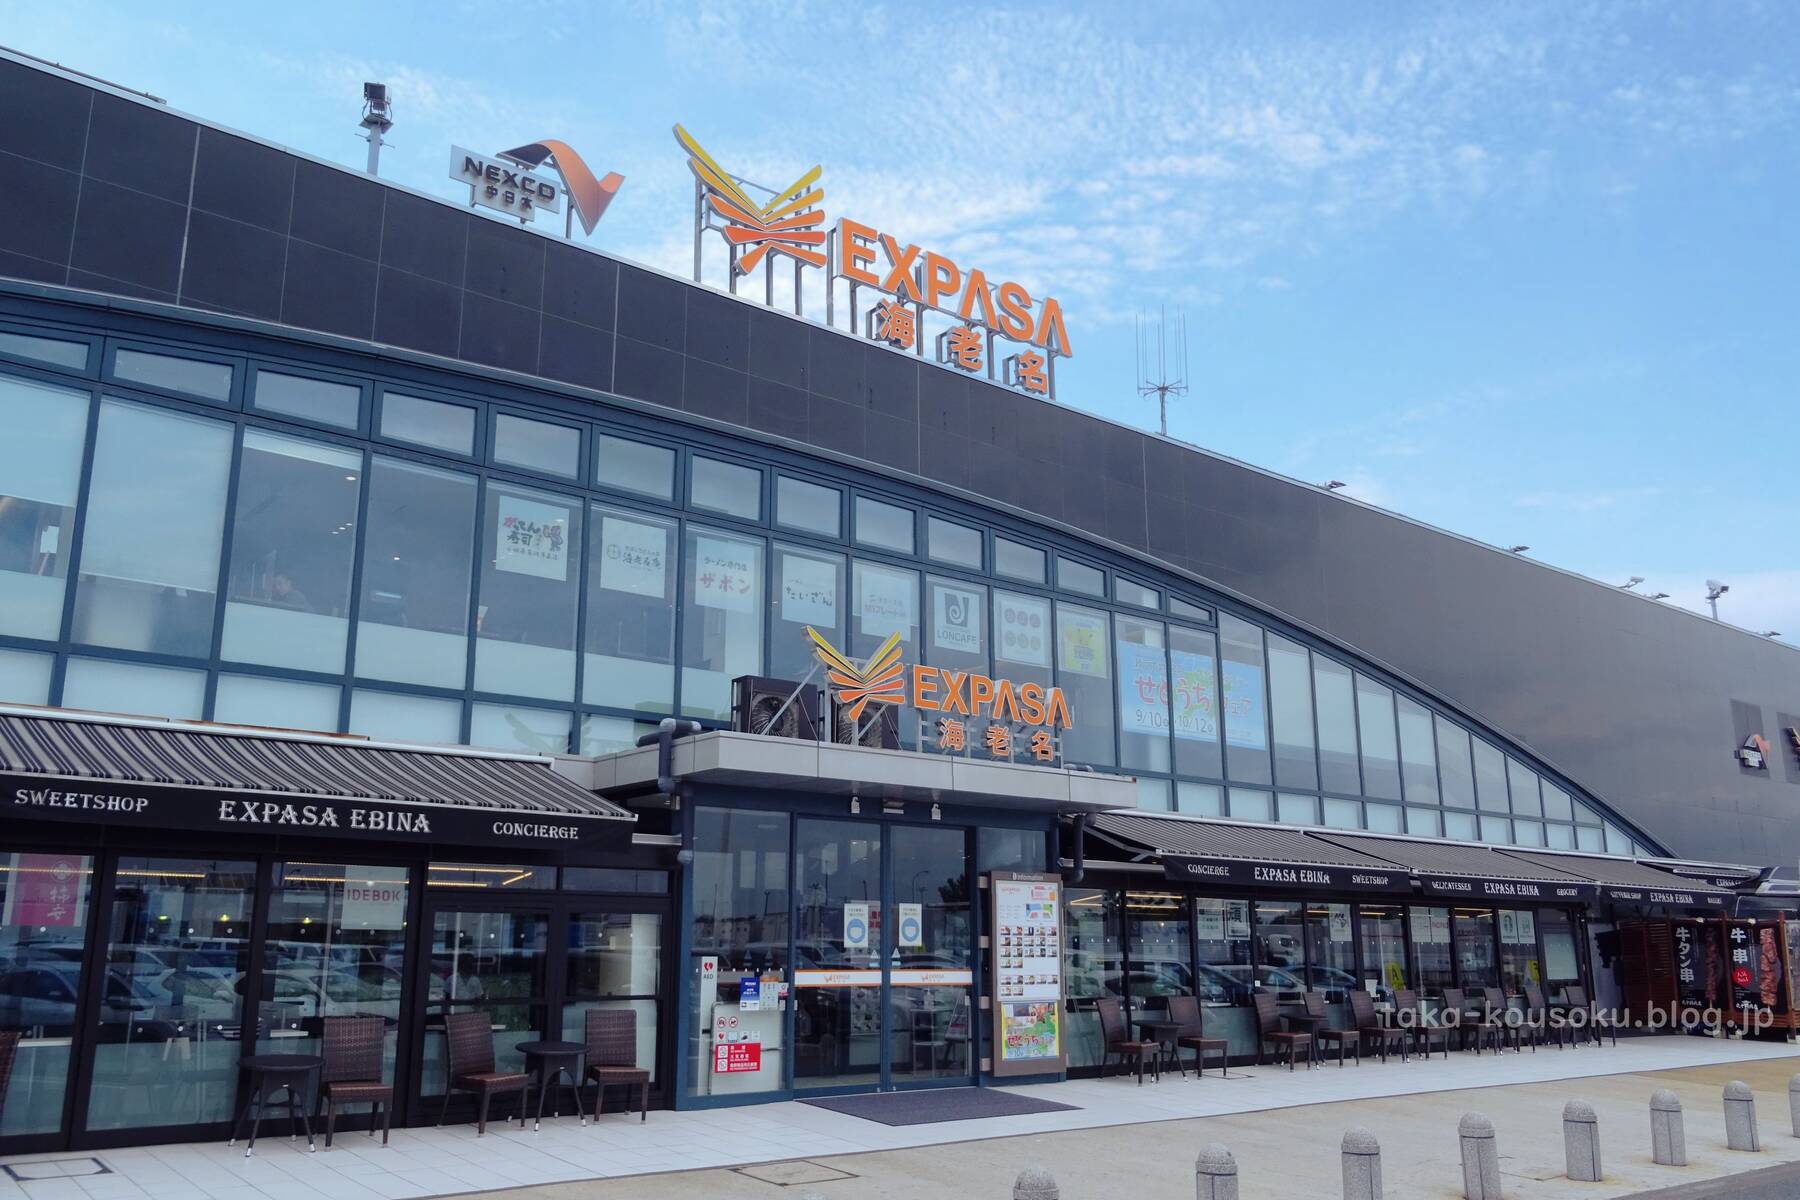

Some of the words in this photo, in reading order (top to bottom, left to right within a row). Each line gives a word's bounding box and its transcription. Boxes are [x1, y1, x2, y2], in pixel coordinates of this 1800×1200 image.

[464, 156, 556, 202] NEXCO
[486, 185, 533, 210] 中日本
[837, 217, 1073, 358] EXPASA
[877, 299, 1049, 395] 海老名
[700, 572, 751, 594] ザボン
[936, 629, 978, 645] LONCAFE
[913, 664, 1073, 730] EXPASA
[939, 716, 1054, 762] 海老名
[14, 788, 149, 813] SWEETSHOP
[218, 800, 340, 828] EXPASA
[350, 808, 432, 833] EBINA
[492, 821, 580, 840] CONCIERGE
[1187, 863, 1230, 876] CONCIERGE
[1254, 867, 1298, 882] EXPASA
[1299, 870, 1331, 884] EBINA
[1352, 874, 1389, 885] SWEETSHOP
[346, 888, 402, 903] IDEBOK
[1484, 882, 1516, 895] EXPASA
[1517, 885, 1540, 896] EBINA
[1650, 892, 1675, 903] EXPASA
[1675, 926, 1694, 983] 牛タン串
[1730, 927, 1749, 964] 牛串
